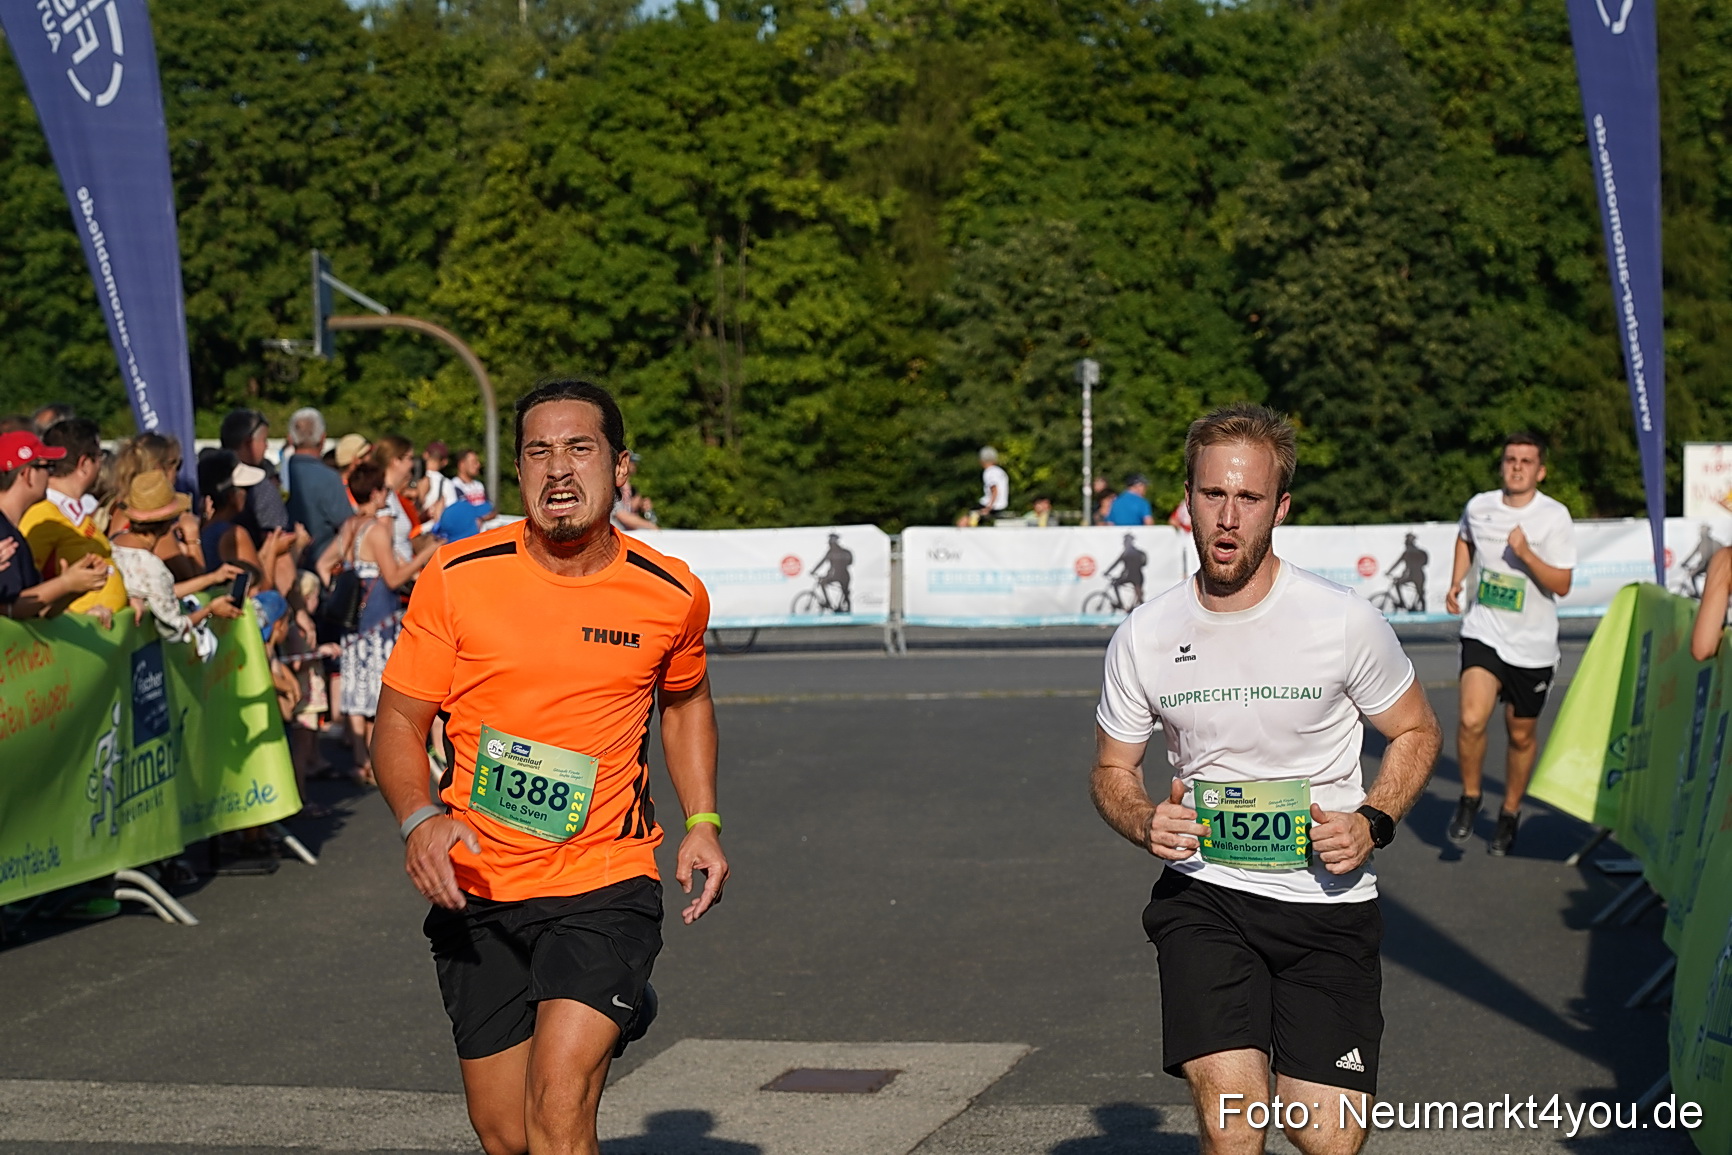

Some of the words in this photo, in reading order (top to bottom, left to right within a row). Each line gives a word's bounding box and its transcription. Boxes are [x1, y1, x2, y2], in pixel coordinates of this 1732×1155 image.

[581, 626, 640, 648] THULE
[1174, 654, 1197, 663] erima
[1159, 687, 1241, 709] RUPPRECHT
[1250, 686, 1323, 699] HOLZBAU
[503, 752, 543, 766] Firmenlauf
[477, 765, 490, 797] RUN
[491, 763, 570, 812] 1388
[499, 797, 518, 812] Lee
[519, 804, 548, 822] Sven
[565, 791, 586, 833] 2022
[1220, 797, 1257, 806] Firmenlauf
[1202, 818, 1213, 848] RN
[1213, 810, 1292, 842] 1520
[1295, 815, 1307, 856] 2022
[1212, 840, 1268, 852] Weißenborn
[1271, 843, 1296, 852] Marc
[1335, 1060, 1365, 1073] adidas
